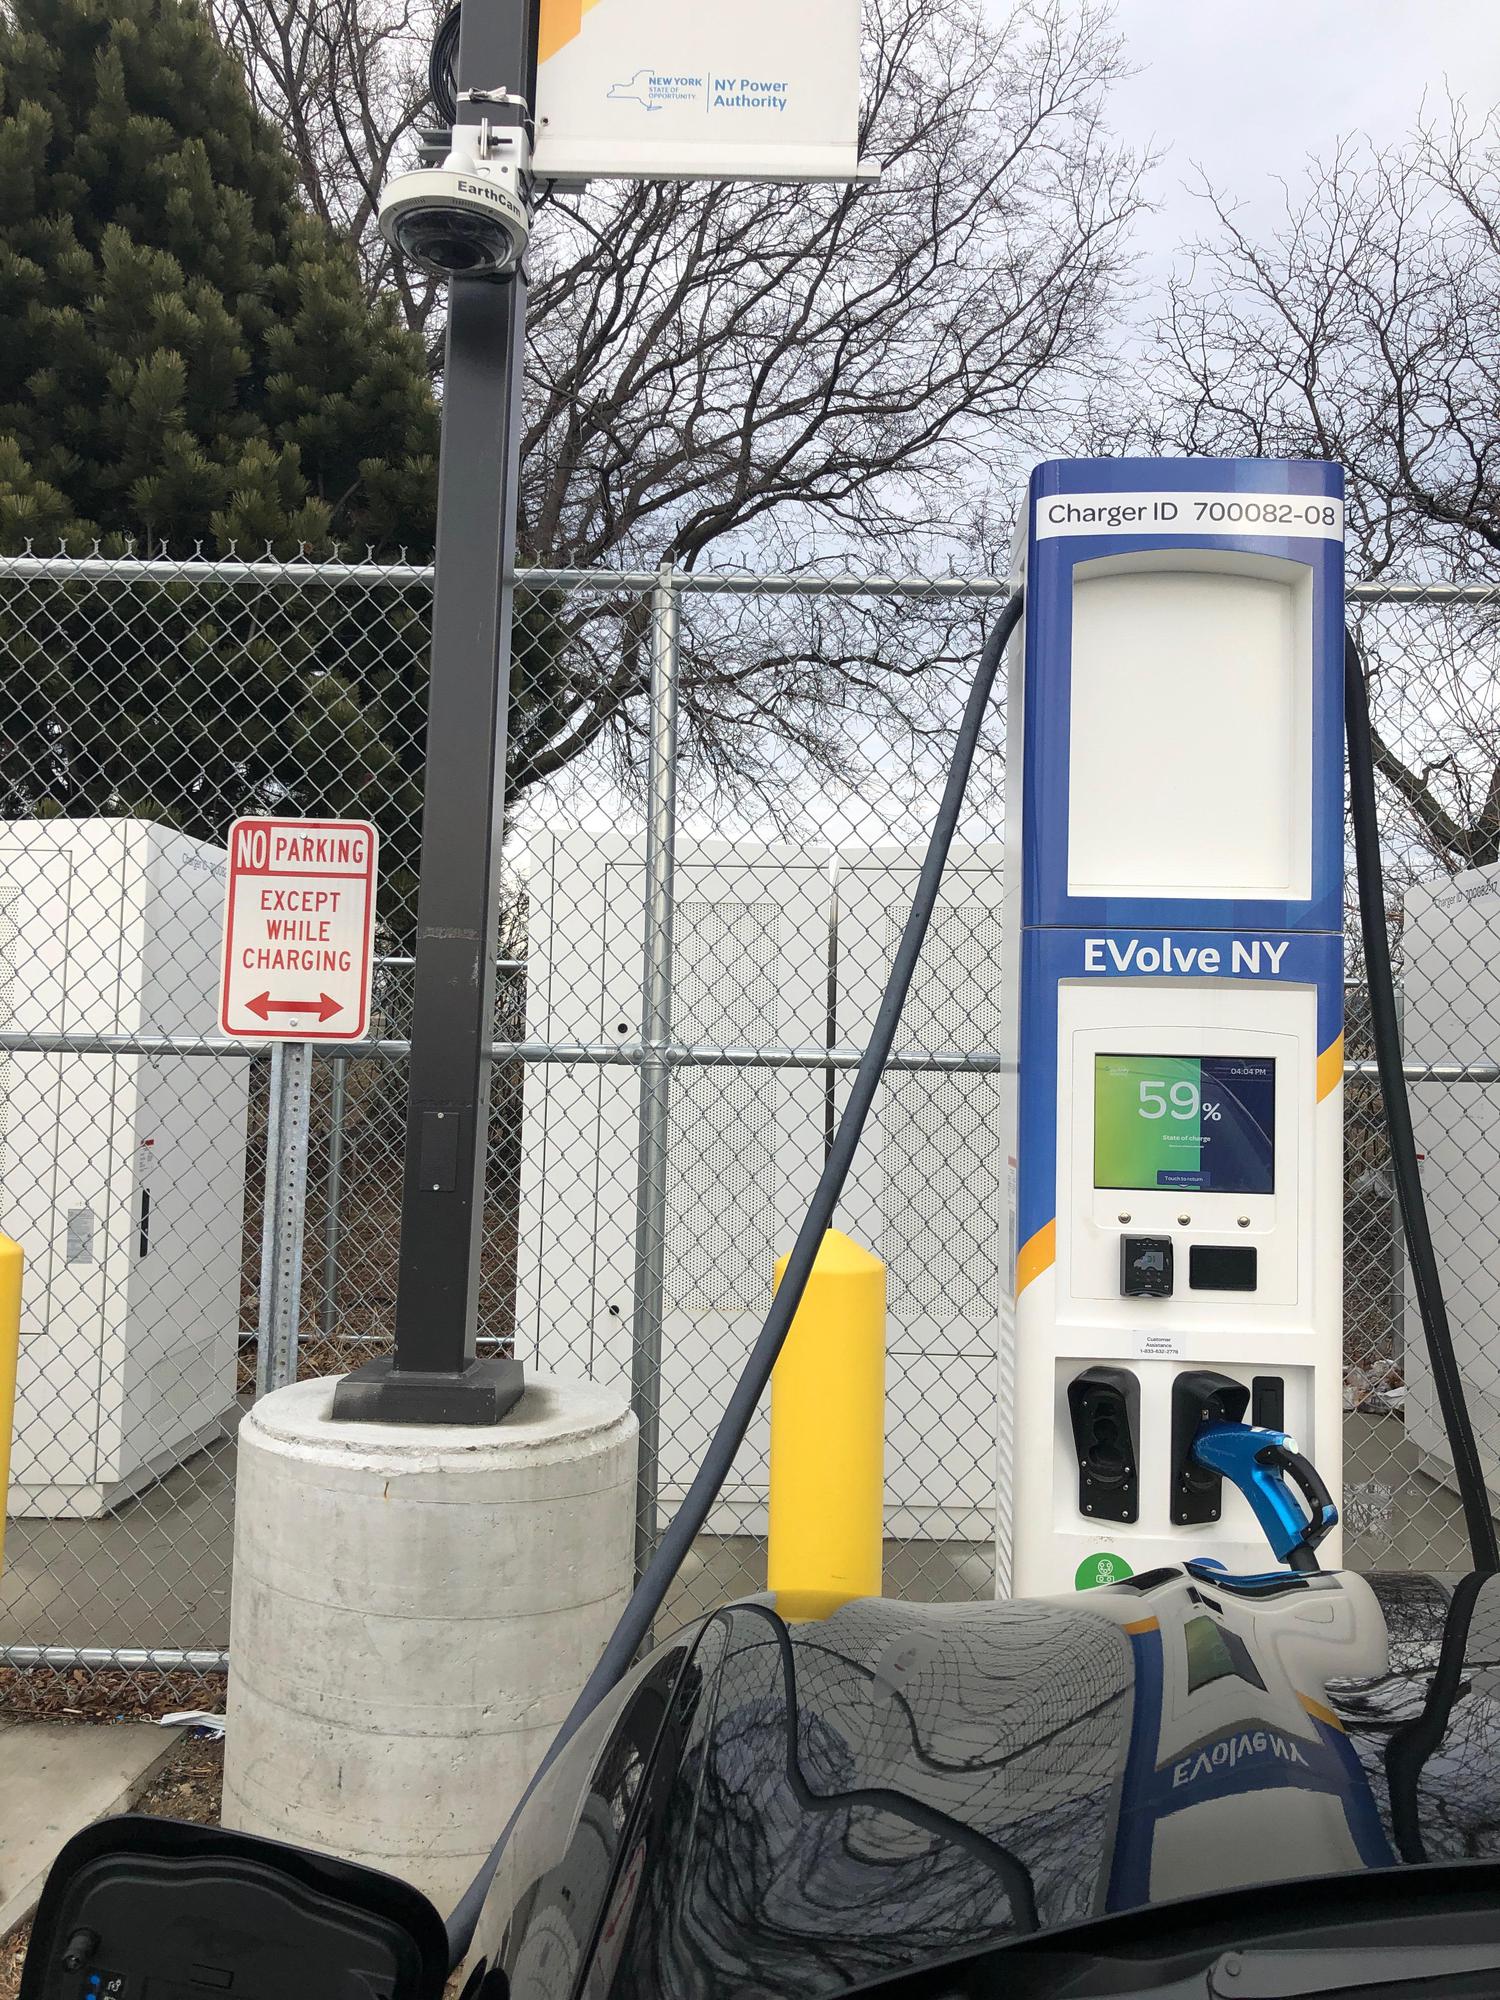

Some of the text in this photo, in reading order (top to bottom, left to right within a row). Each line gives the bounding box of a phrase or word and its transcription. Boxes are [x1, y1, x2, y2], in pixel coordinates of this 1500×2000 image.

[649, 77, 702, 87] NEW YORK
[714, 79, 788, 92] NY Power
[713, 95, 787, 111] Authority
[457, 180, 521, 218] EarthCam
[1048, 502, 1336, 526] Charger ID 700082-08
[236, 829, 364, 869] NO PARKING
[260, 889, 341, 913] EXCEPT
[266, 919, 331, 942] WHILE
[242, 948, 351, 972] CHARGING
[1084, 937, 1290, 974] EVolve NY
[1189, 1135, 1211, 1143] charge
